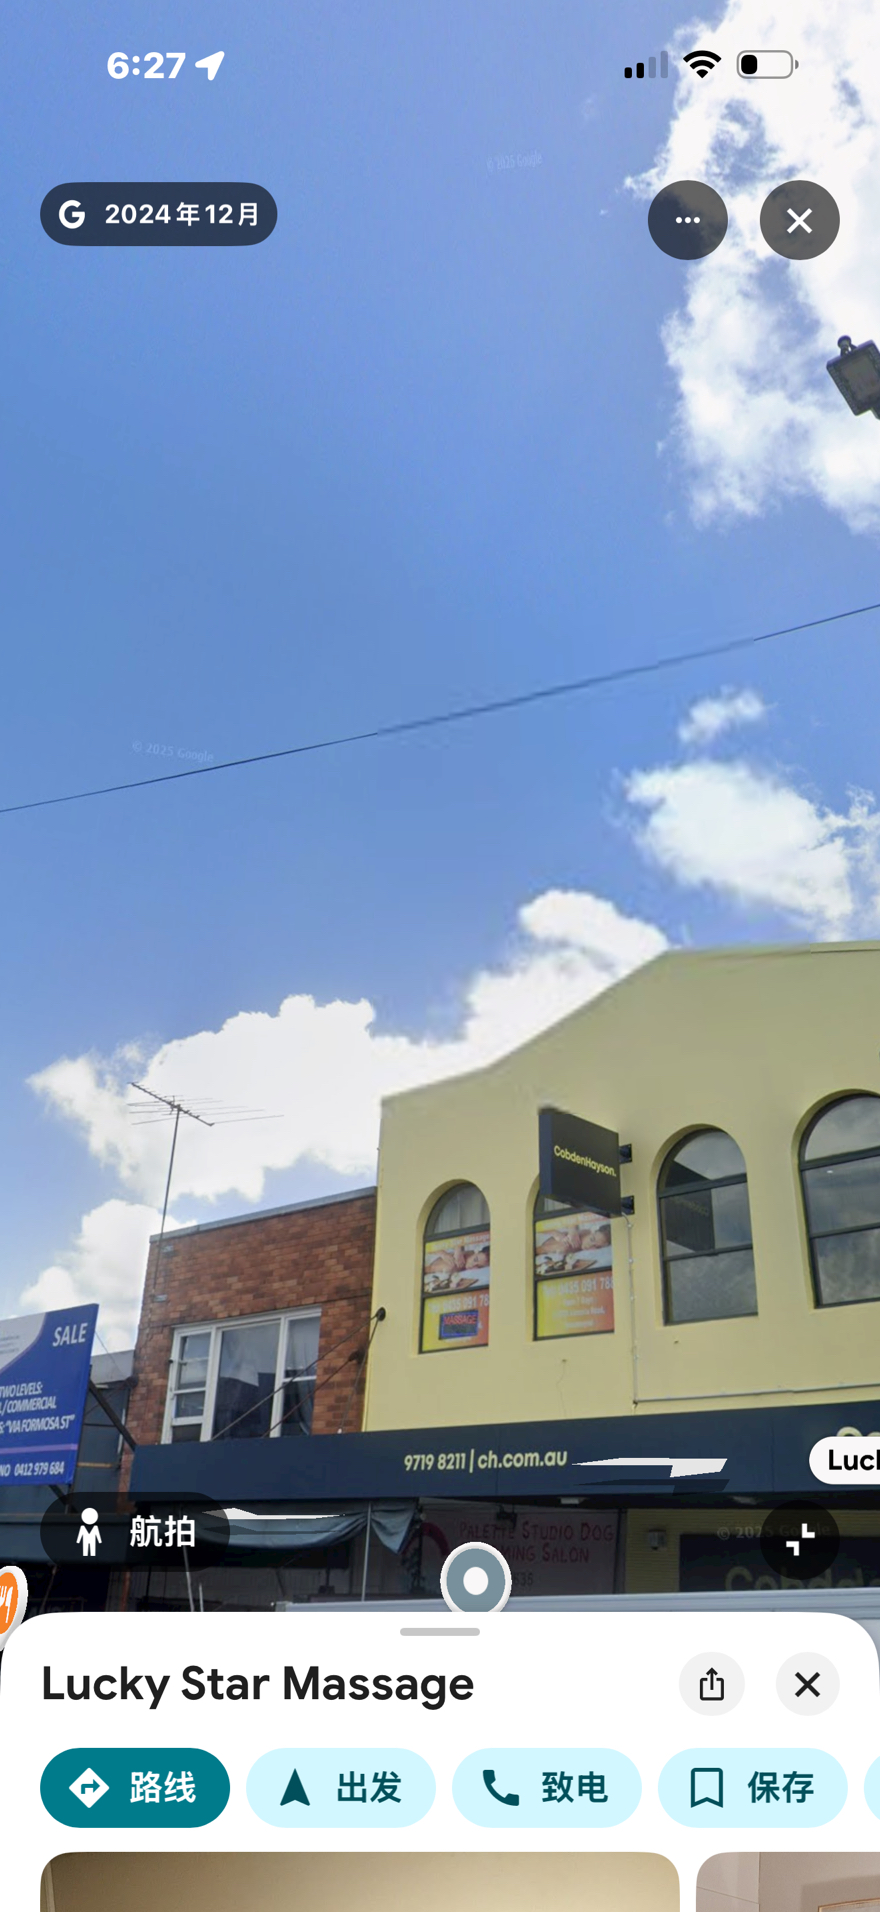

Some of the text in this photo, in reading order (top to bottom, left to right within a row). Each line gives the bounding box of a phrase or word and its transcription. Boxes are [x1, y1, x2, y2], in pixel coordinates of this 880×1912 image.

[52, 1323, 88, 1347] SALE
[14, 1462, 34, 1477] 0412
[33, 1461, 48, 1476] 979
[49, 1461, 65, 1475] 684
[404, 1453, 435, 1471] 9719
[437, 1452, 466, 1470] 8211
[477, 1450, 568, 1470] ch.com.au
[522, 1521, 574, 1541] STUDIO
[581, 1522, 615, 1541] DOG
[542, 1542, 589, 1563] SALON
